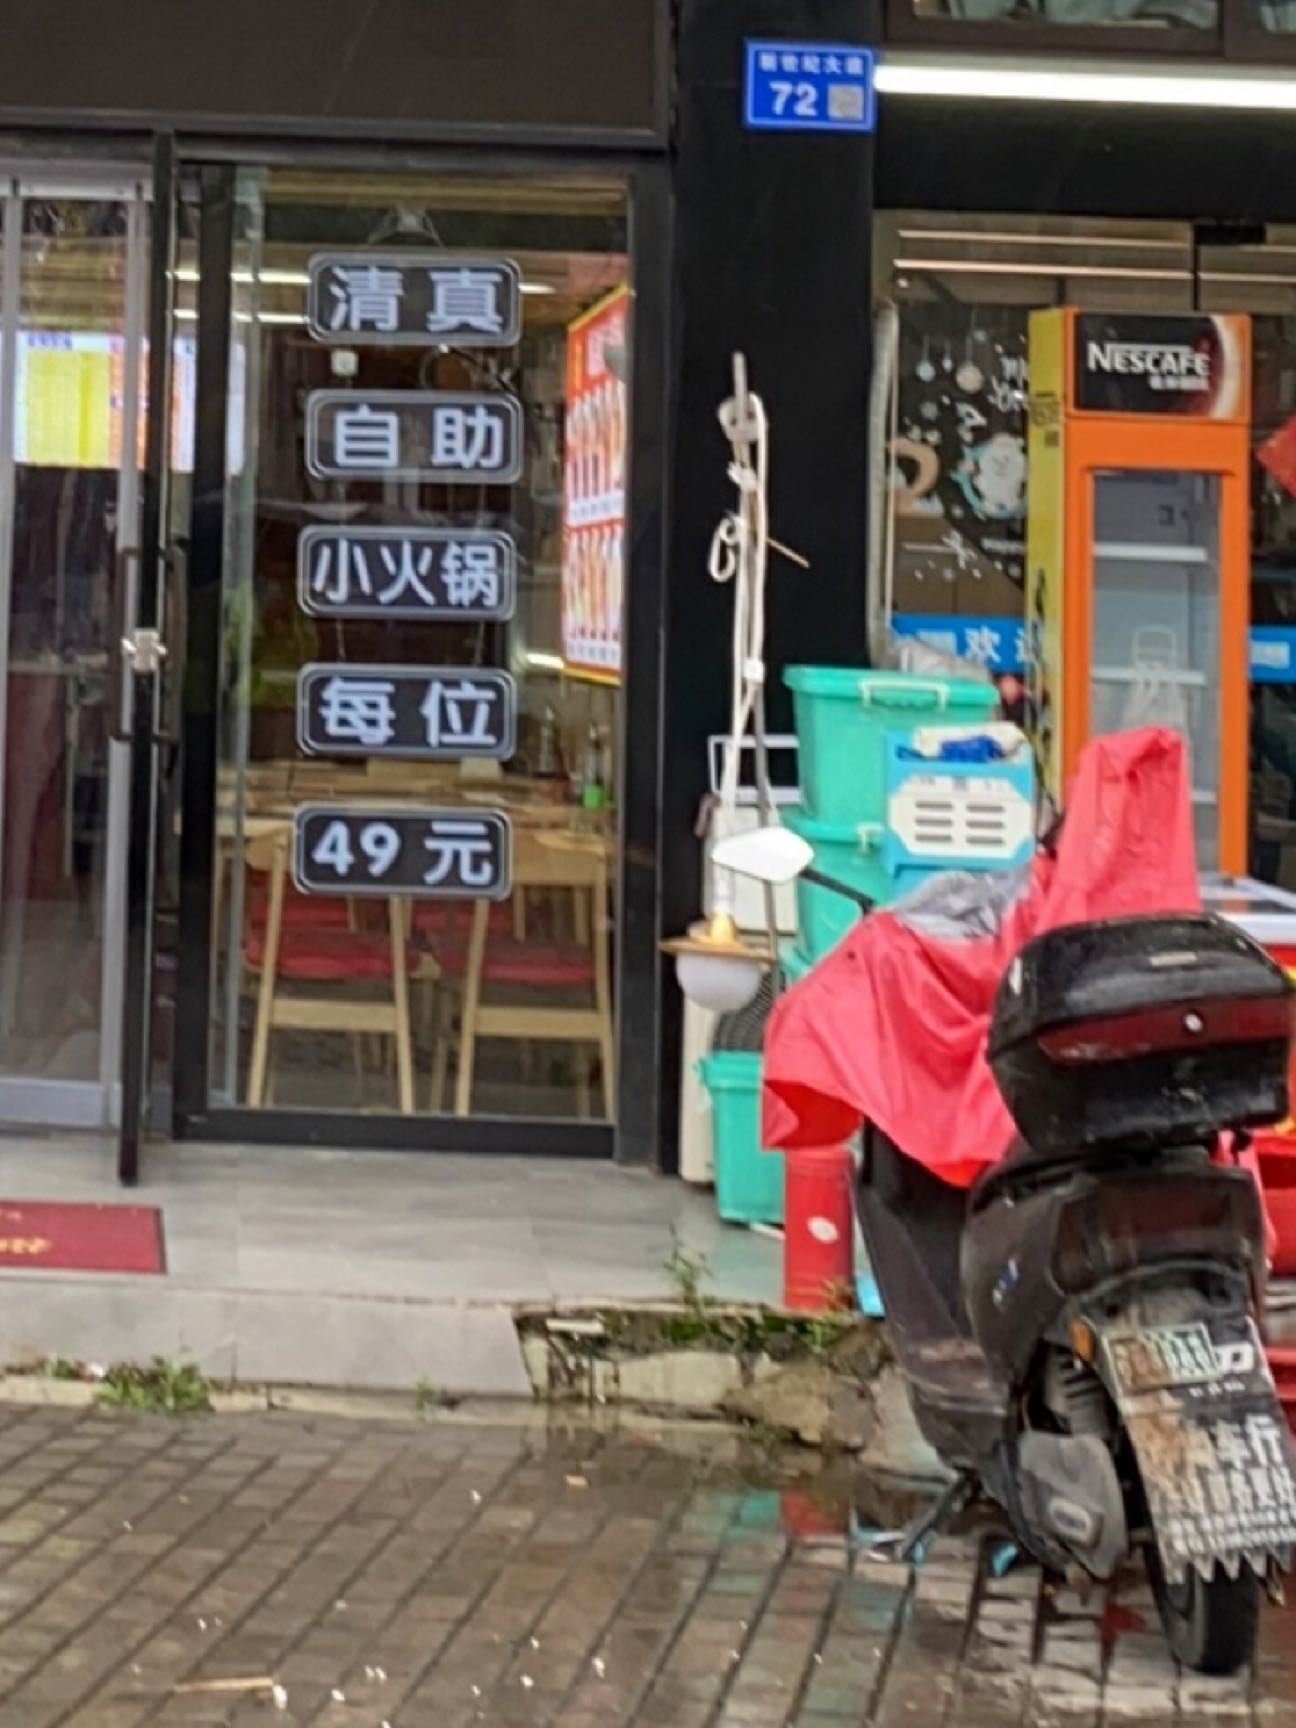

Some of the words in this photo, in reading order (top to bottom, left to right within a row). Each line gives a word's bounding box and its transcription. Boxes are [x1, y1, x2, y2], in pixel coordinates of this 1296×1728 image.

[768, 80, 819, 117] 72
[330, 265, 503, 334] 清真
[333, 404, 503, 471] 自助
[312, 539, 498, 608] 小火锅
[320, 678, 497, 748] 每位
[312, 820, 494, 884] 49元
